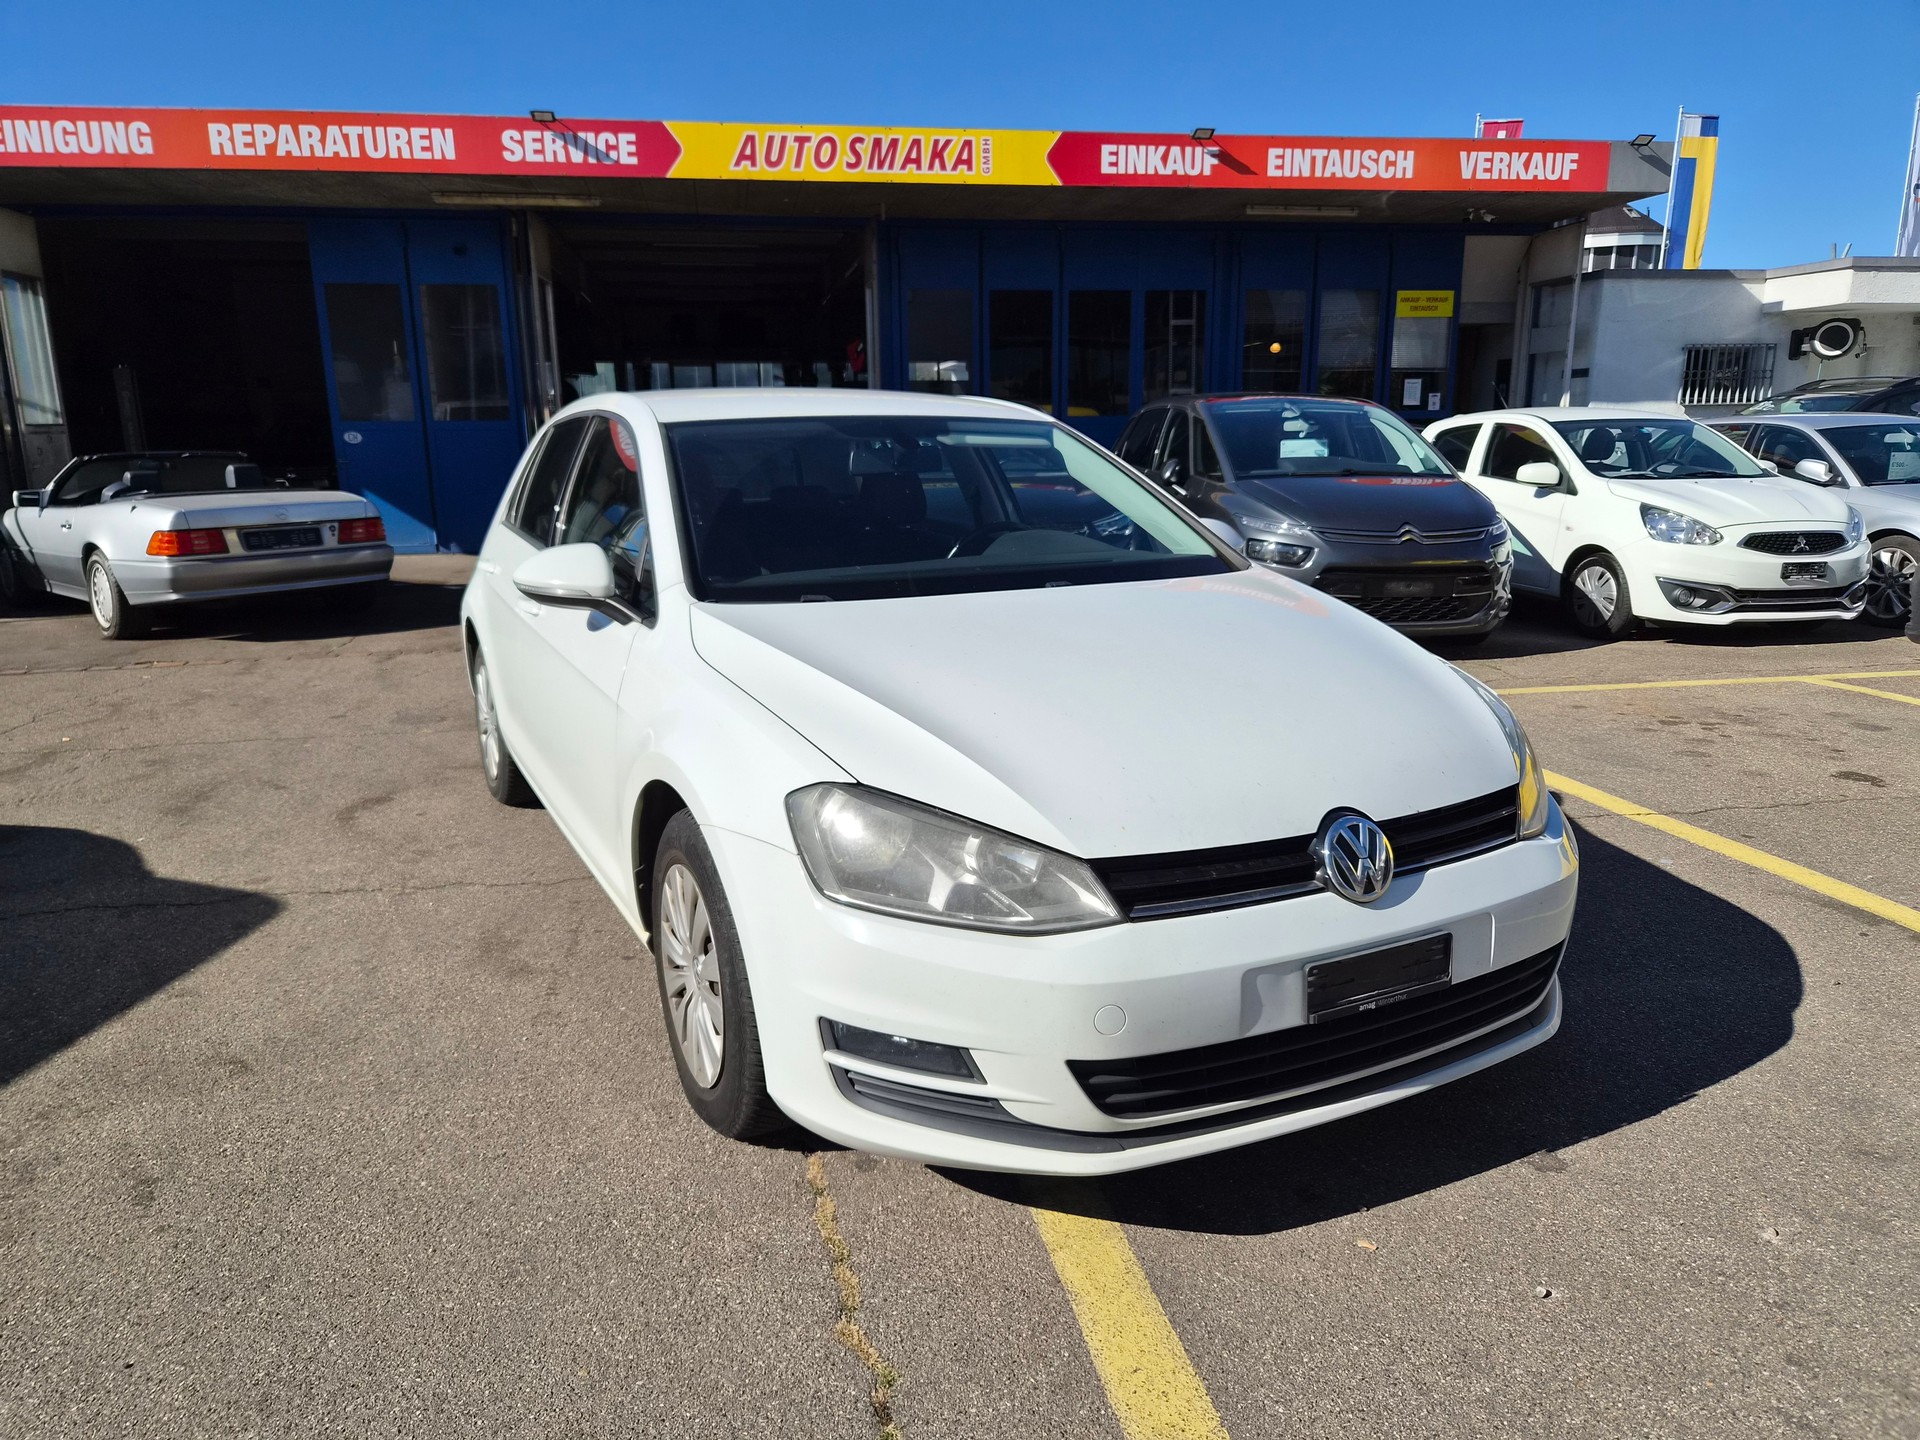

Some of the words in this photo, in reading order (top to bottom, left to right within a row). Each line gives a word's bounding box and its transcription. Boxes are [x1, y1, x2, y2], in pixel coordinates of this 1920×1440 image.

[207, 122, 456, 161] REPARATUREN
[501, 129, 639, 165] SERVICE
[982, 138, 991, 174] GMBH
[1100, 144, 1220, 176] EINKAUF
[1266, 147, 1415, 179] EINTAUSCH
[1459, 150, 1579, 181] VERKAUF
[1359, 1001, 1376, 1011] amag
